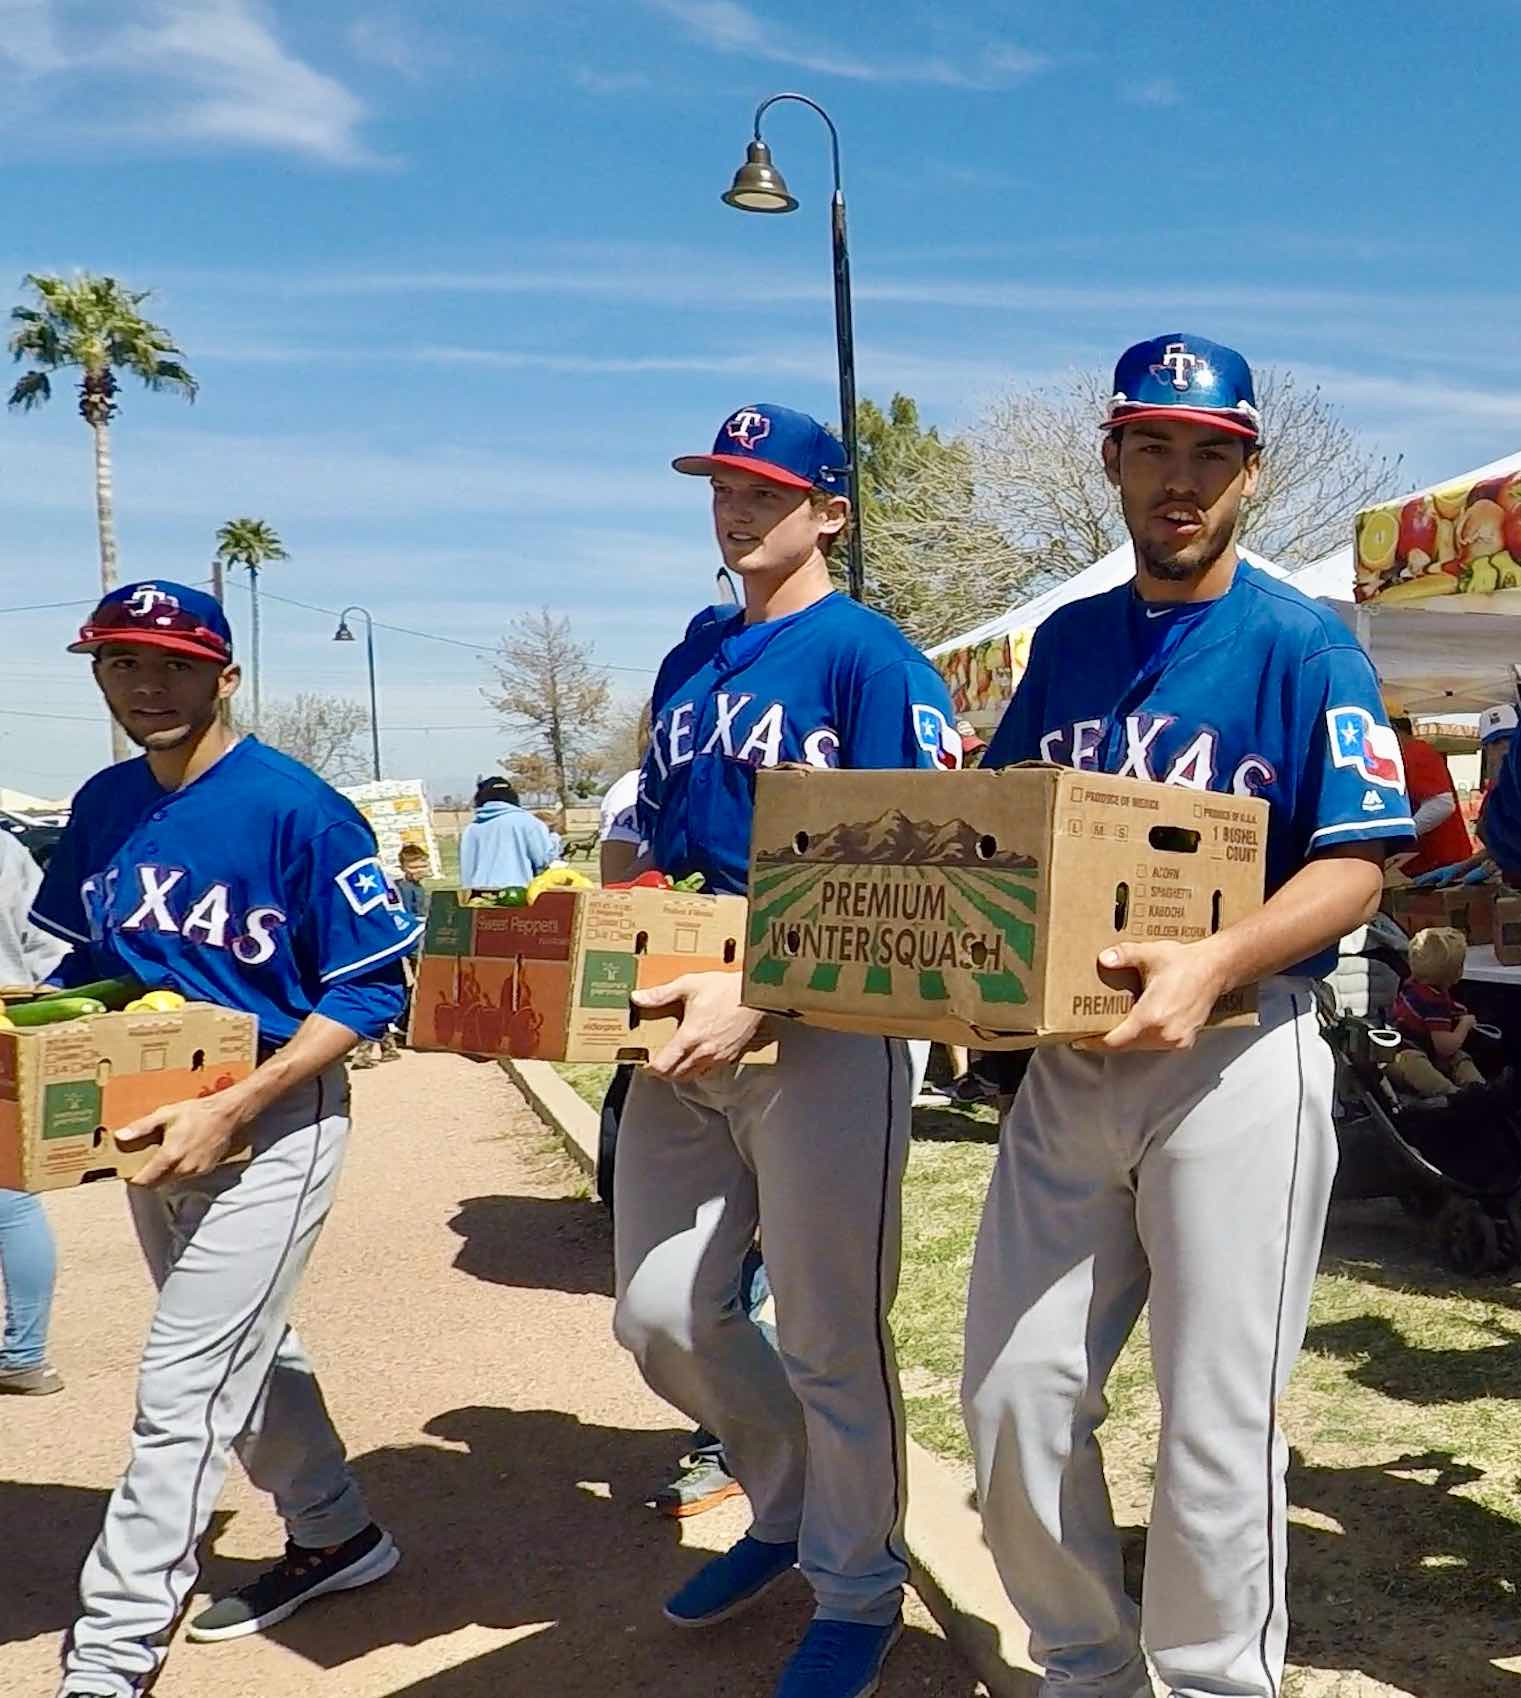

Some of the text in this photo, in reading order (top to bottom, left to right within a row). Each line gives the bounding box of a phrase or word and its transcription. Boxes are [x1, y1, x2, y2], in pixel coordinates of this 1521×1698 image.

[1162, 353, 1196, 390] T
[734, 412, 761, 438] T
[1151, 867, 1180, 879] ACORN
[821, 881, 945, 921] PREMIUM
[1146, 924, 1178, 937] GOLDEN
[770, 921, 1003, 971] WNTER SQUASH
[1073, 995, 1133, 1016] PREMIU
